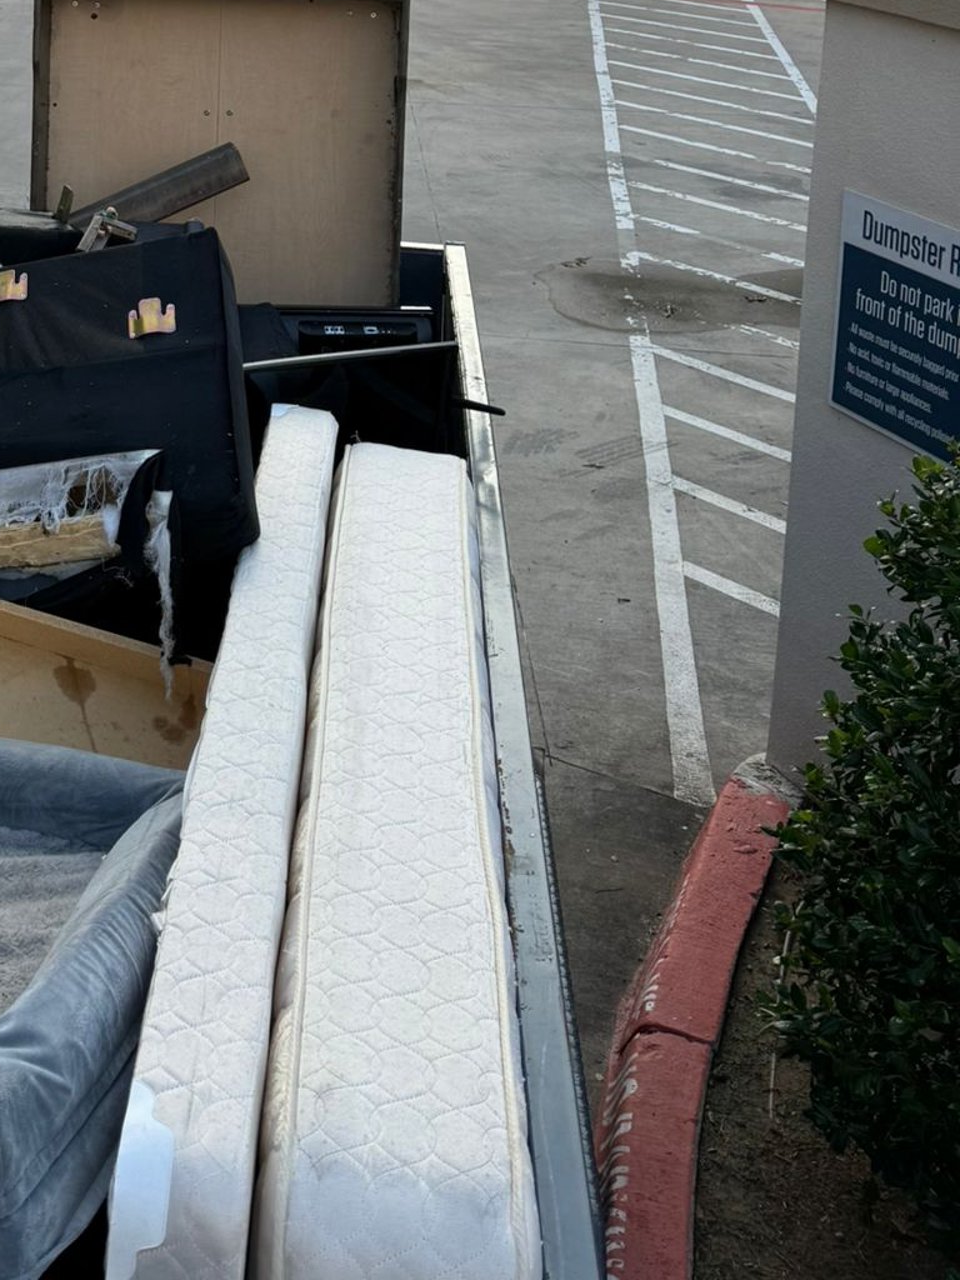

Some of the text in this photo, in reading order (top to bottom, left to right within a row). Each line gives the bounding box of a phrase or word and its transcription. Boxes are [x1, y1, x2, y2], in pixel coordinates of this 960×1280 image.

[862, 210, 945, 270] Dumpster
[856, 287, 885, 321] front
[888, 306, 902, 328] of
[904, 311, 925, 339] the
[880, 270, 897, 297] Do
[900, 283, 921, 308] not
[924, 293, 955, 323] park
[898, 346, 922, 367] securely
[923, 355, 945, 377] bagged
